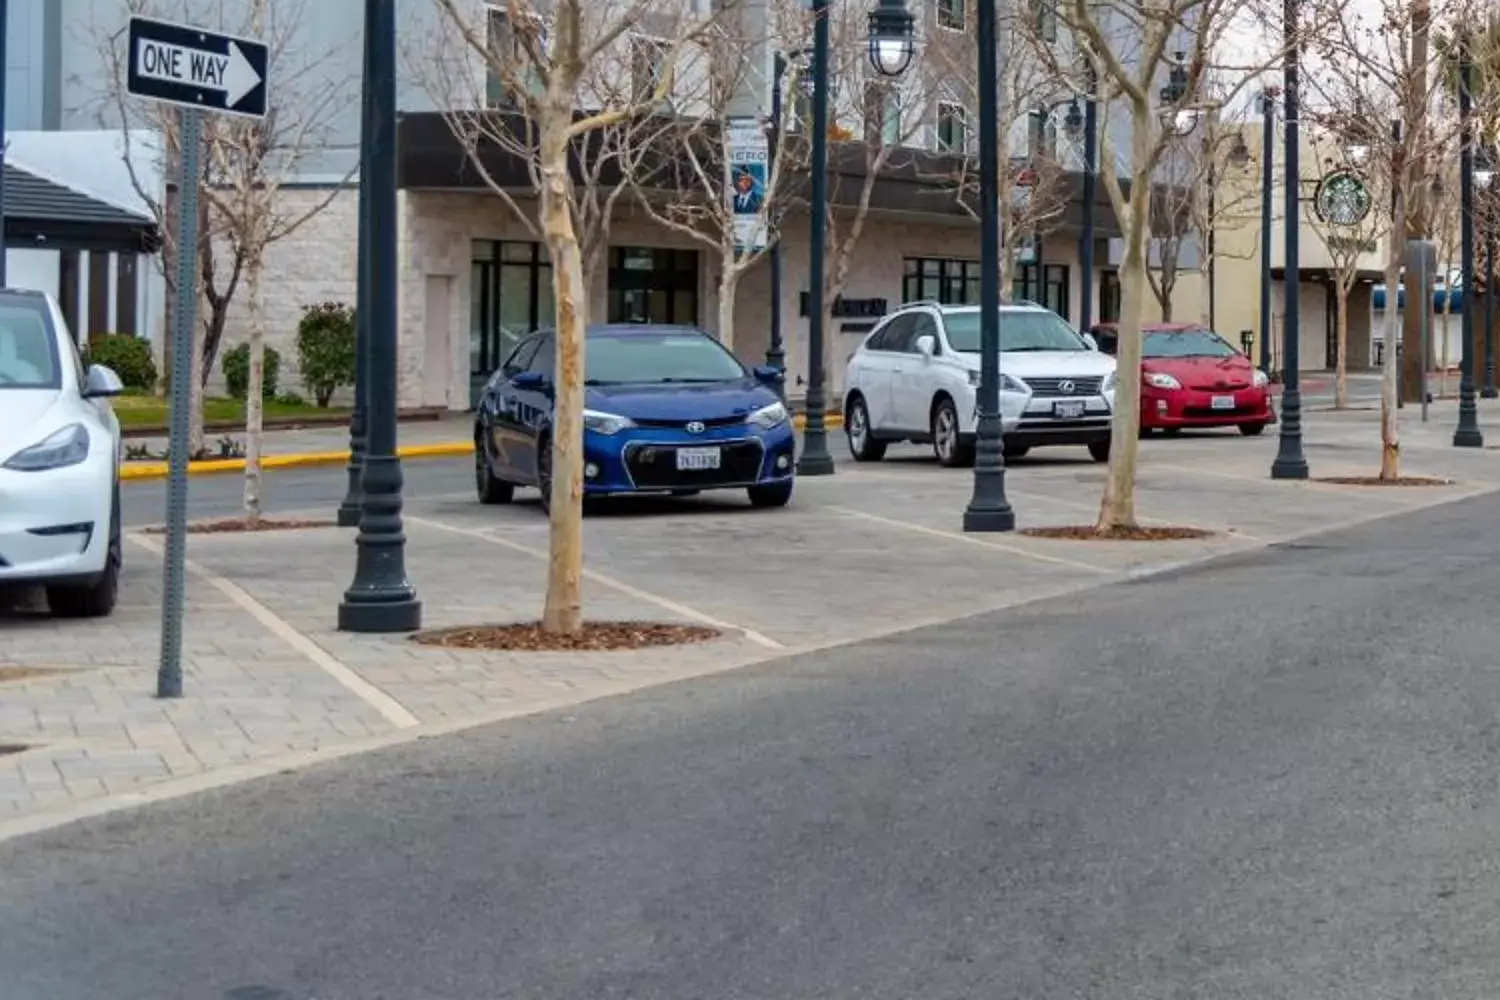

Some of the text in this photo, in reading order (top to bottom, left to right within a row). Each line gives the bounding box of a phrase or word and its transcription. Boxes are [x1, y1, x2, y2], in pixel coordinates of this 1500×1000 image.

[143, 43, 228, 86] ONE WAY
[731, 151, 767, 161] ERO
